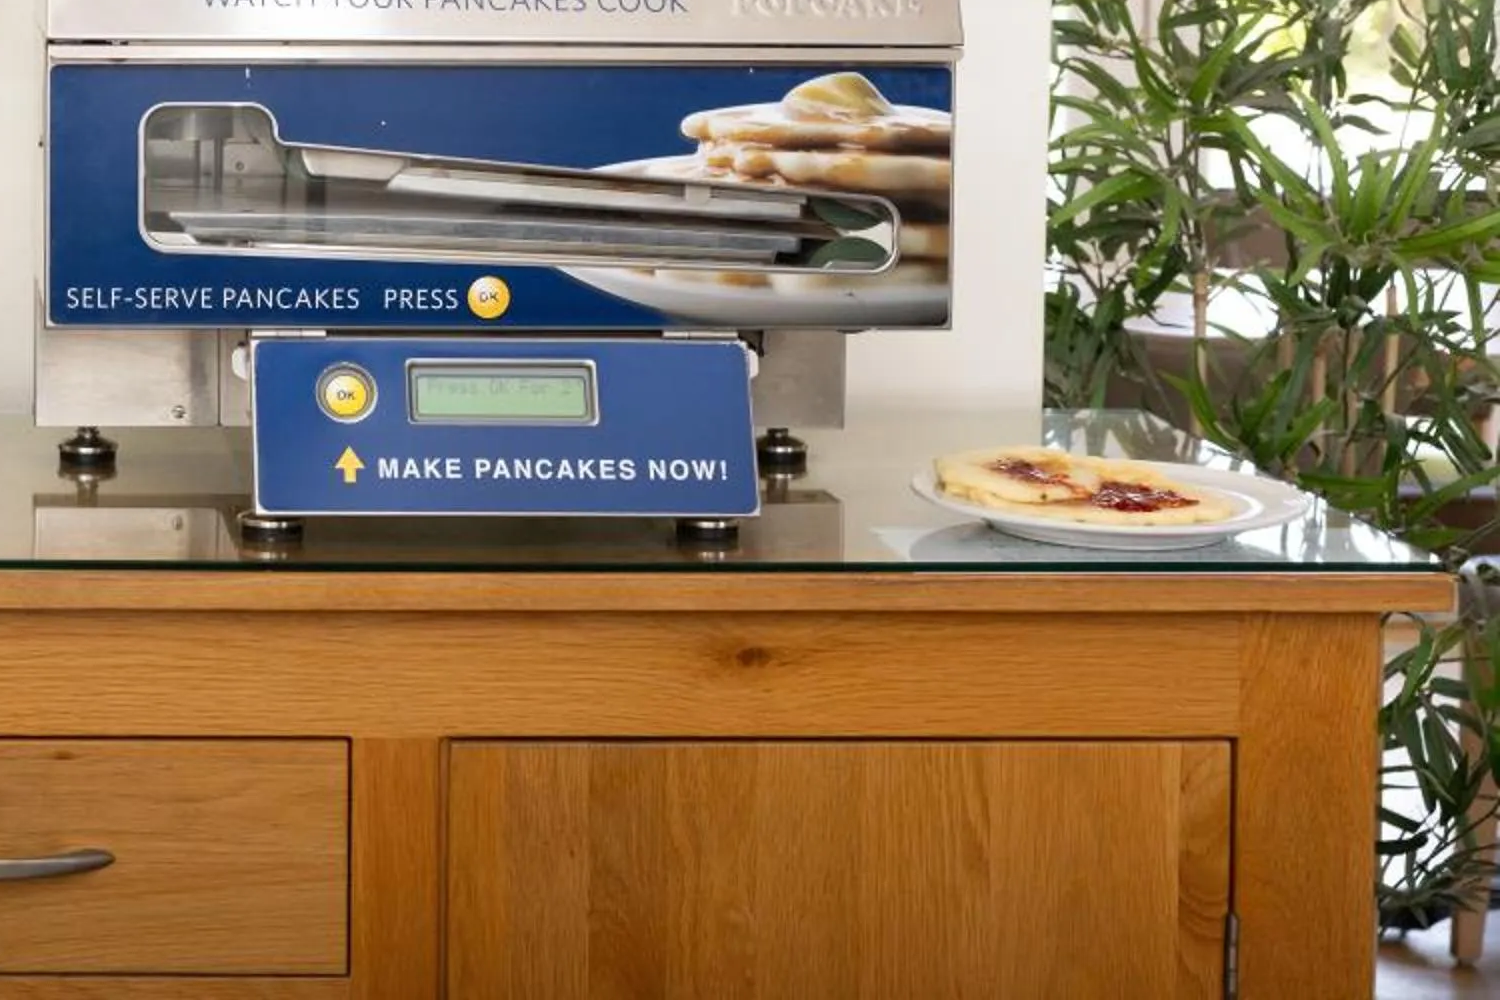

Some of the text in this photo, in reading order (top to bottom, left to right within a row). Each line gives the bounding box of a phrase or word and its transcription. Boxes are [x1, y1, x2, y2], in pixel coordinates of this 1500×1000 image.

[67, 286, 499, 310] SELF-SERVE PANCAKES PRESS OK
[336, 389, 357, 401] OK
[377, 457, 728, 482] MAKE PANCAKES NOW!
